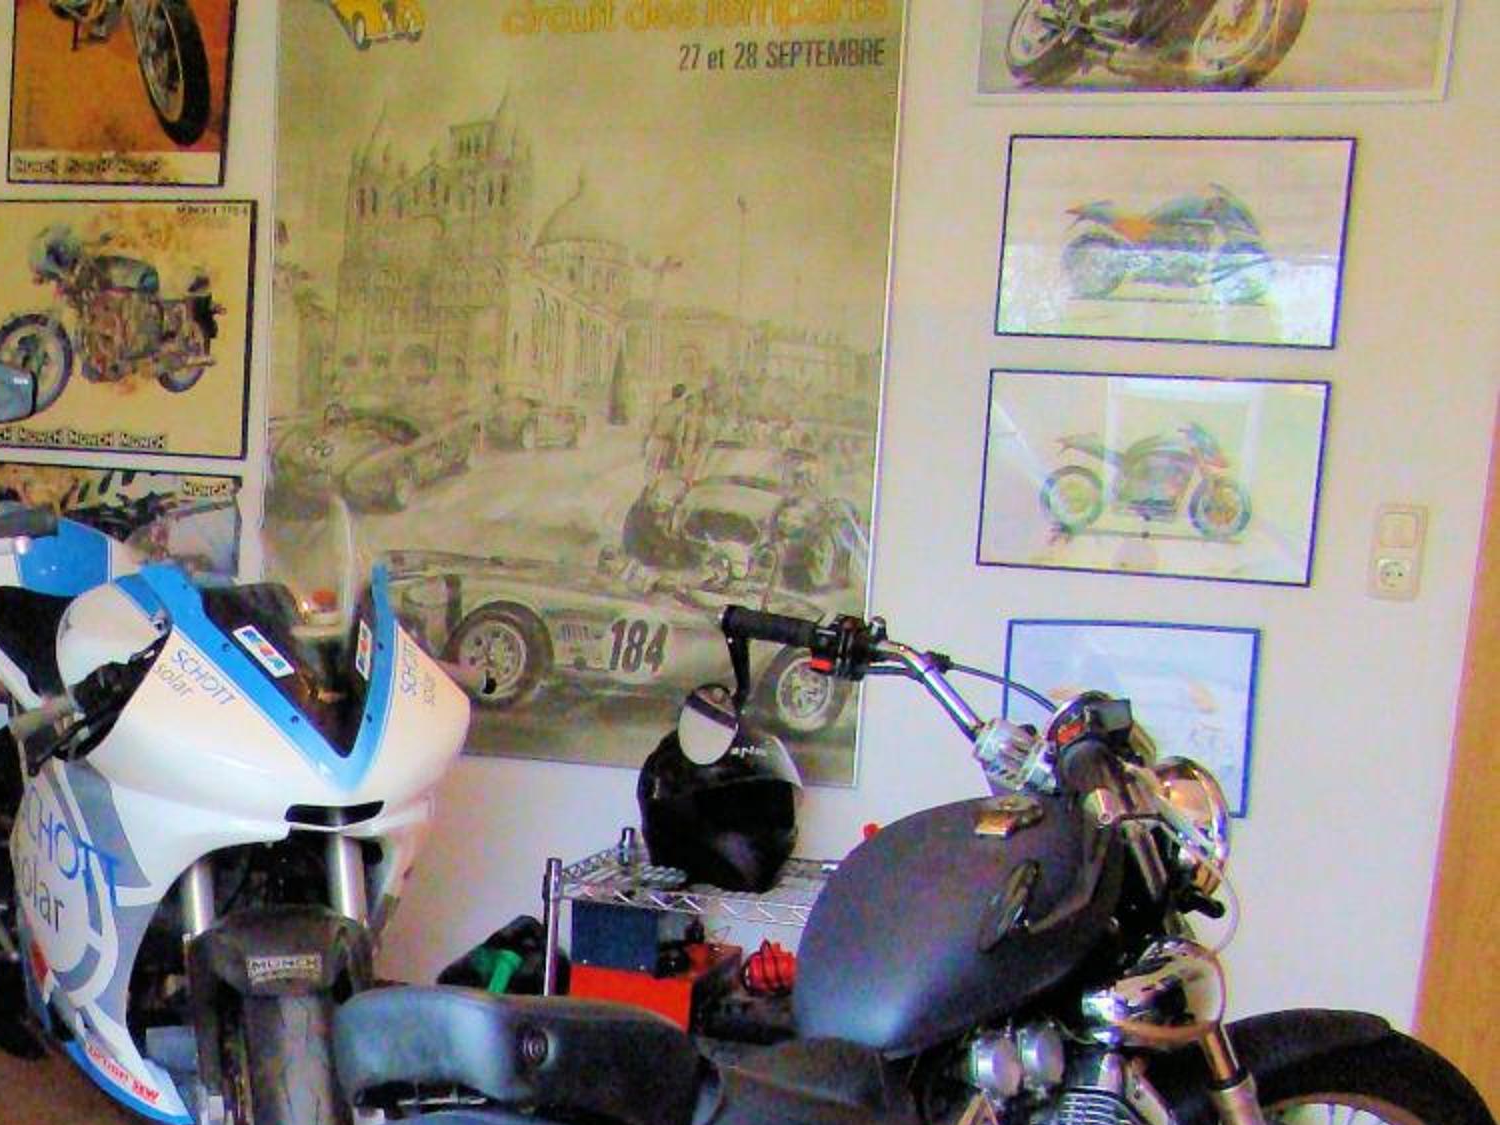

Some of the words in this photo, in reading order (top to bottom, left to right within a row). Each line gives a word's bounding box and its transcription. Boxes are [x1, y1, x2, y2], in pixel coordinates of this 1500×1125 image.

[679, 45, 699, 71] 27
[707, 47, 725, 70] et
[734, 42, 758, 70] 28
[765, 37, 886, 69] SEPTEMBRE
[607, 617, 669, 674] 184
[154, 661, 196, 700] solar
[169, 646, 236, 706] SCHOTT
